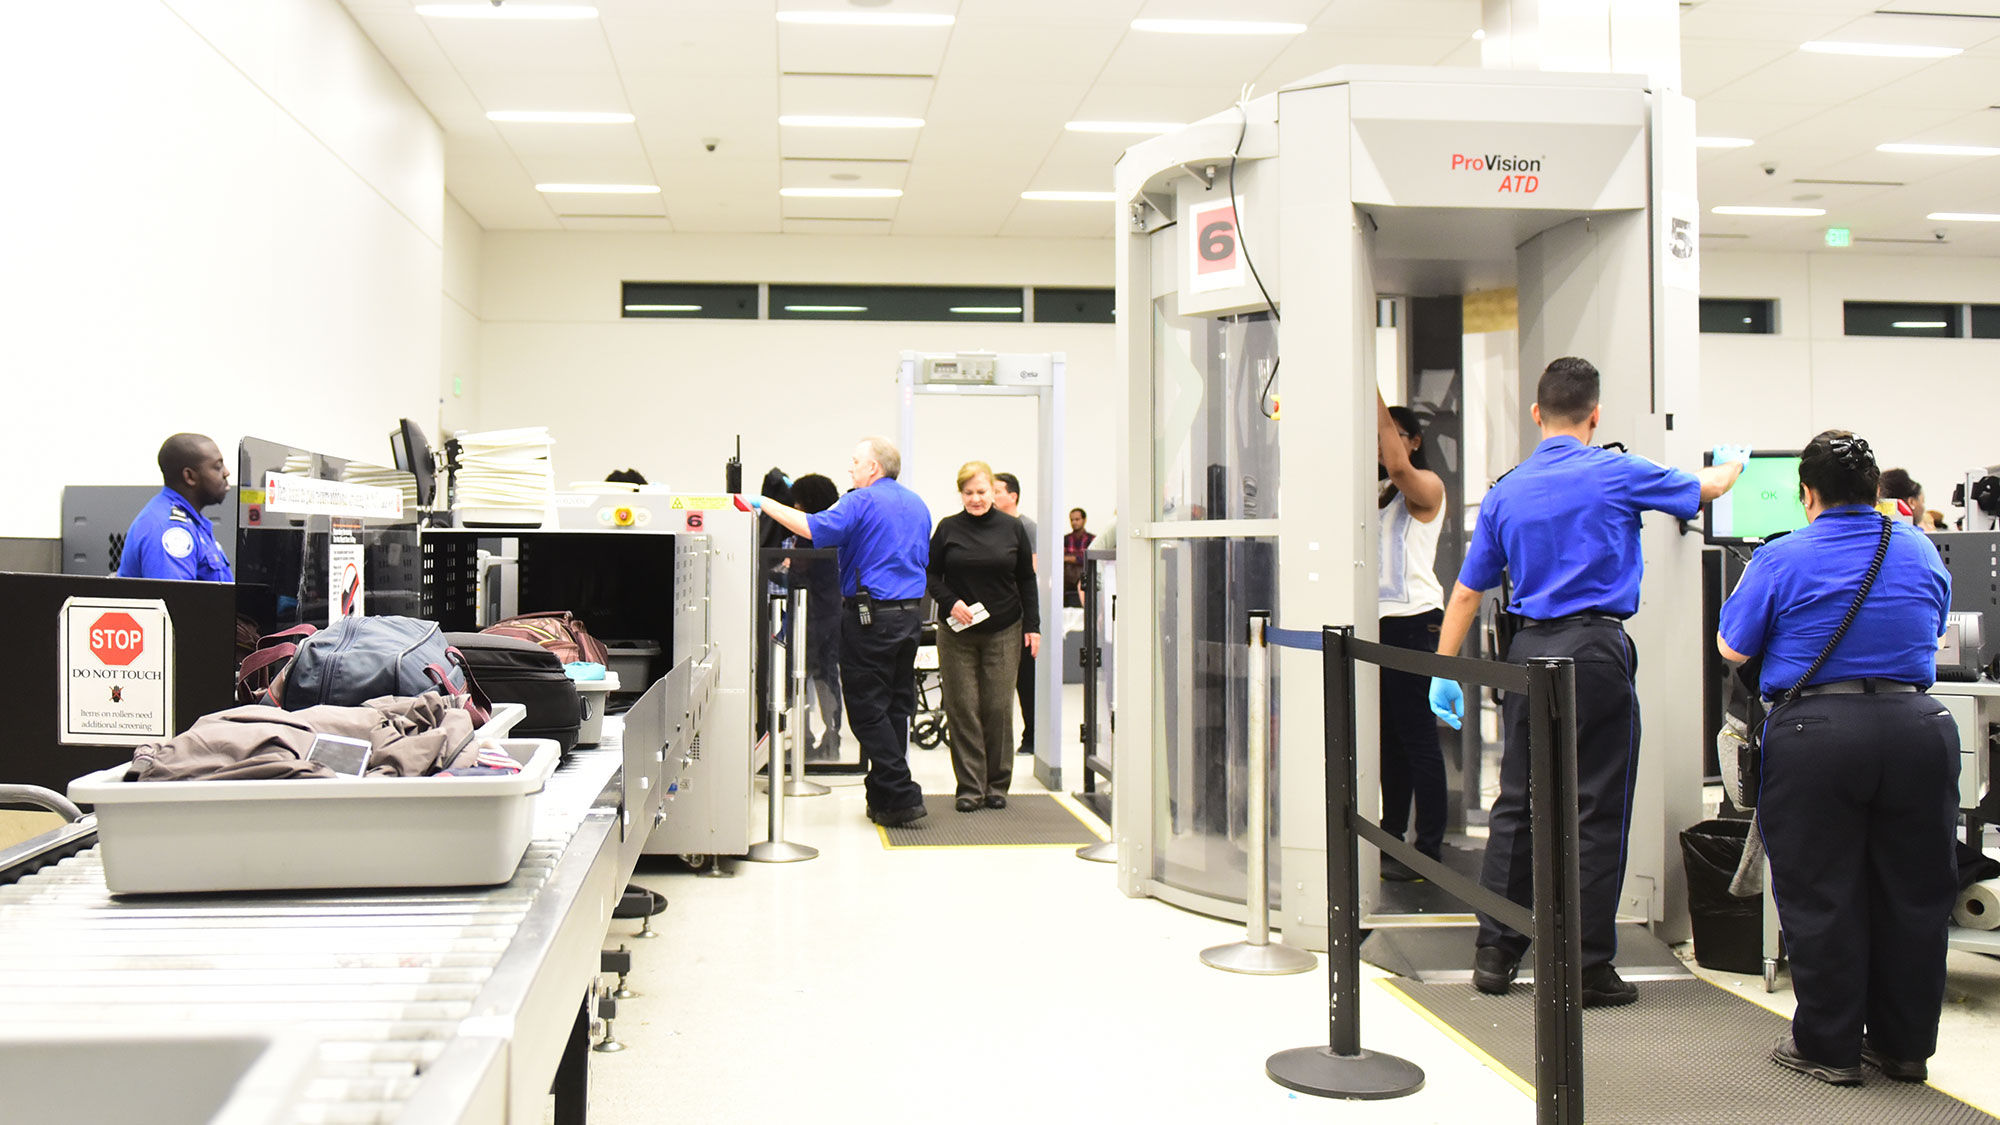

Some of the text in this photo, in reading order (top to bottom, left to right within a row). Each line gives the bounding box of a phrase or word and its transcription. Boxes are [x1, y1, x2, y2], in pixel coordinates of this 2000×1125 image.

[1451, 153, 1541, 172] ProVision
[1497, 175, 1539, 193] ATD
[1199, 221, 1234, 261] 6
[1670, 217, 1693, 259] 5
[1761, 490, 1778, 500] OK
[686, 514, 703, 528] 6
[92, 628, 142, 649] STOP
[72, 668, 162, 681] DO NOT TOUCH
[80, 709, 101, 717] Items
[112, 710, 135, 719] rollers
[135, 711, 153, 719] need
[81, 721, 153, 732] additional screening
